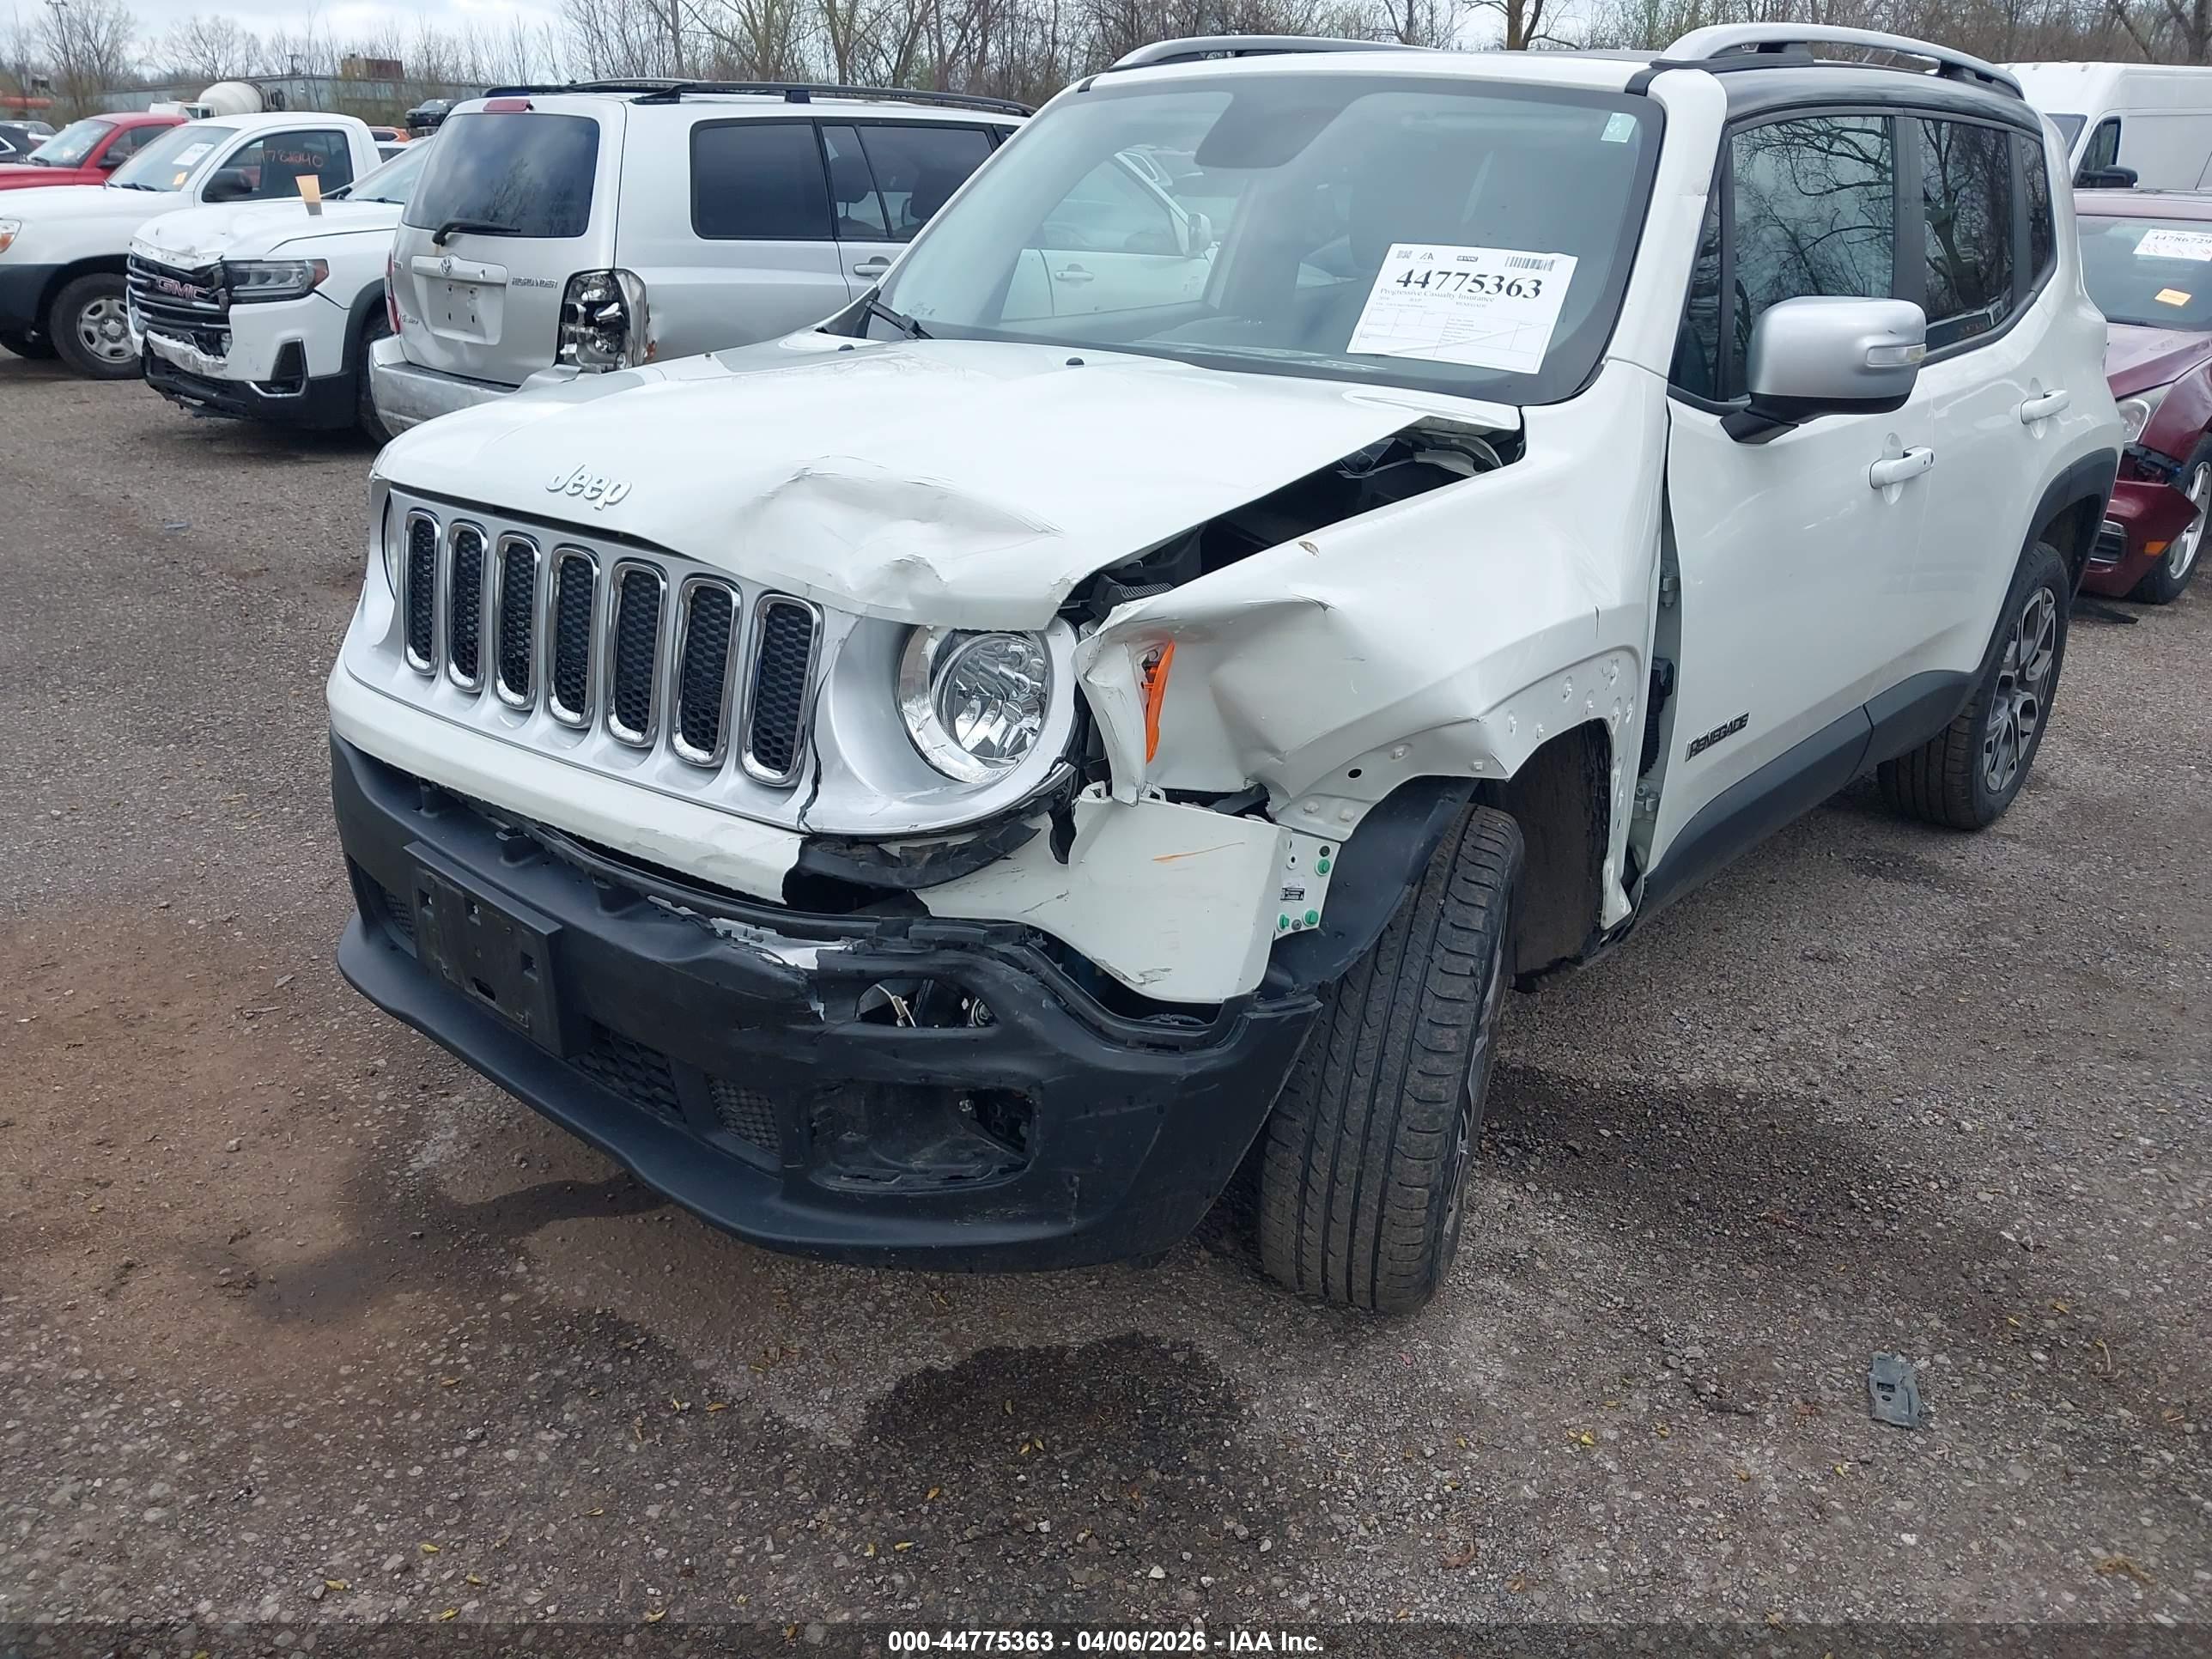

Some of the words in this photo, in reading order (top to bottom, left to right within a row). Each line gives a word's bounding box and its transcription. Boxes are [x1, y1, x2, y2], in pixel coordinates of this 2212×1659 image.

[155, 276, 210, 301] GMC
[1380, 288, 1423, 296] Progressive
[1424, 290, 1455, 301] Casualty
[1395, 269, 1543, 299] 44775363
[544, 463, 632, 512] Jeep
[1685, 712, 1750, 763] RENEGADE
